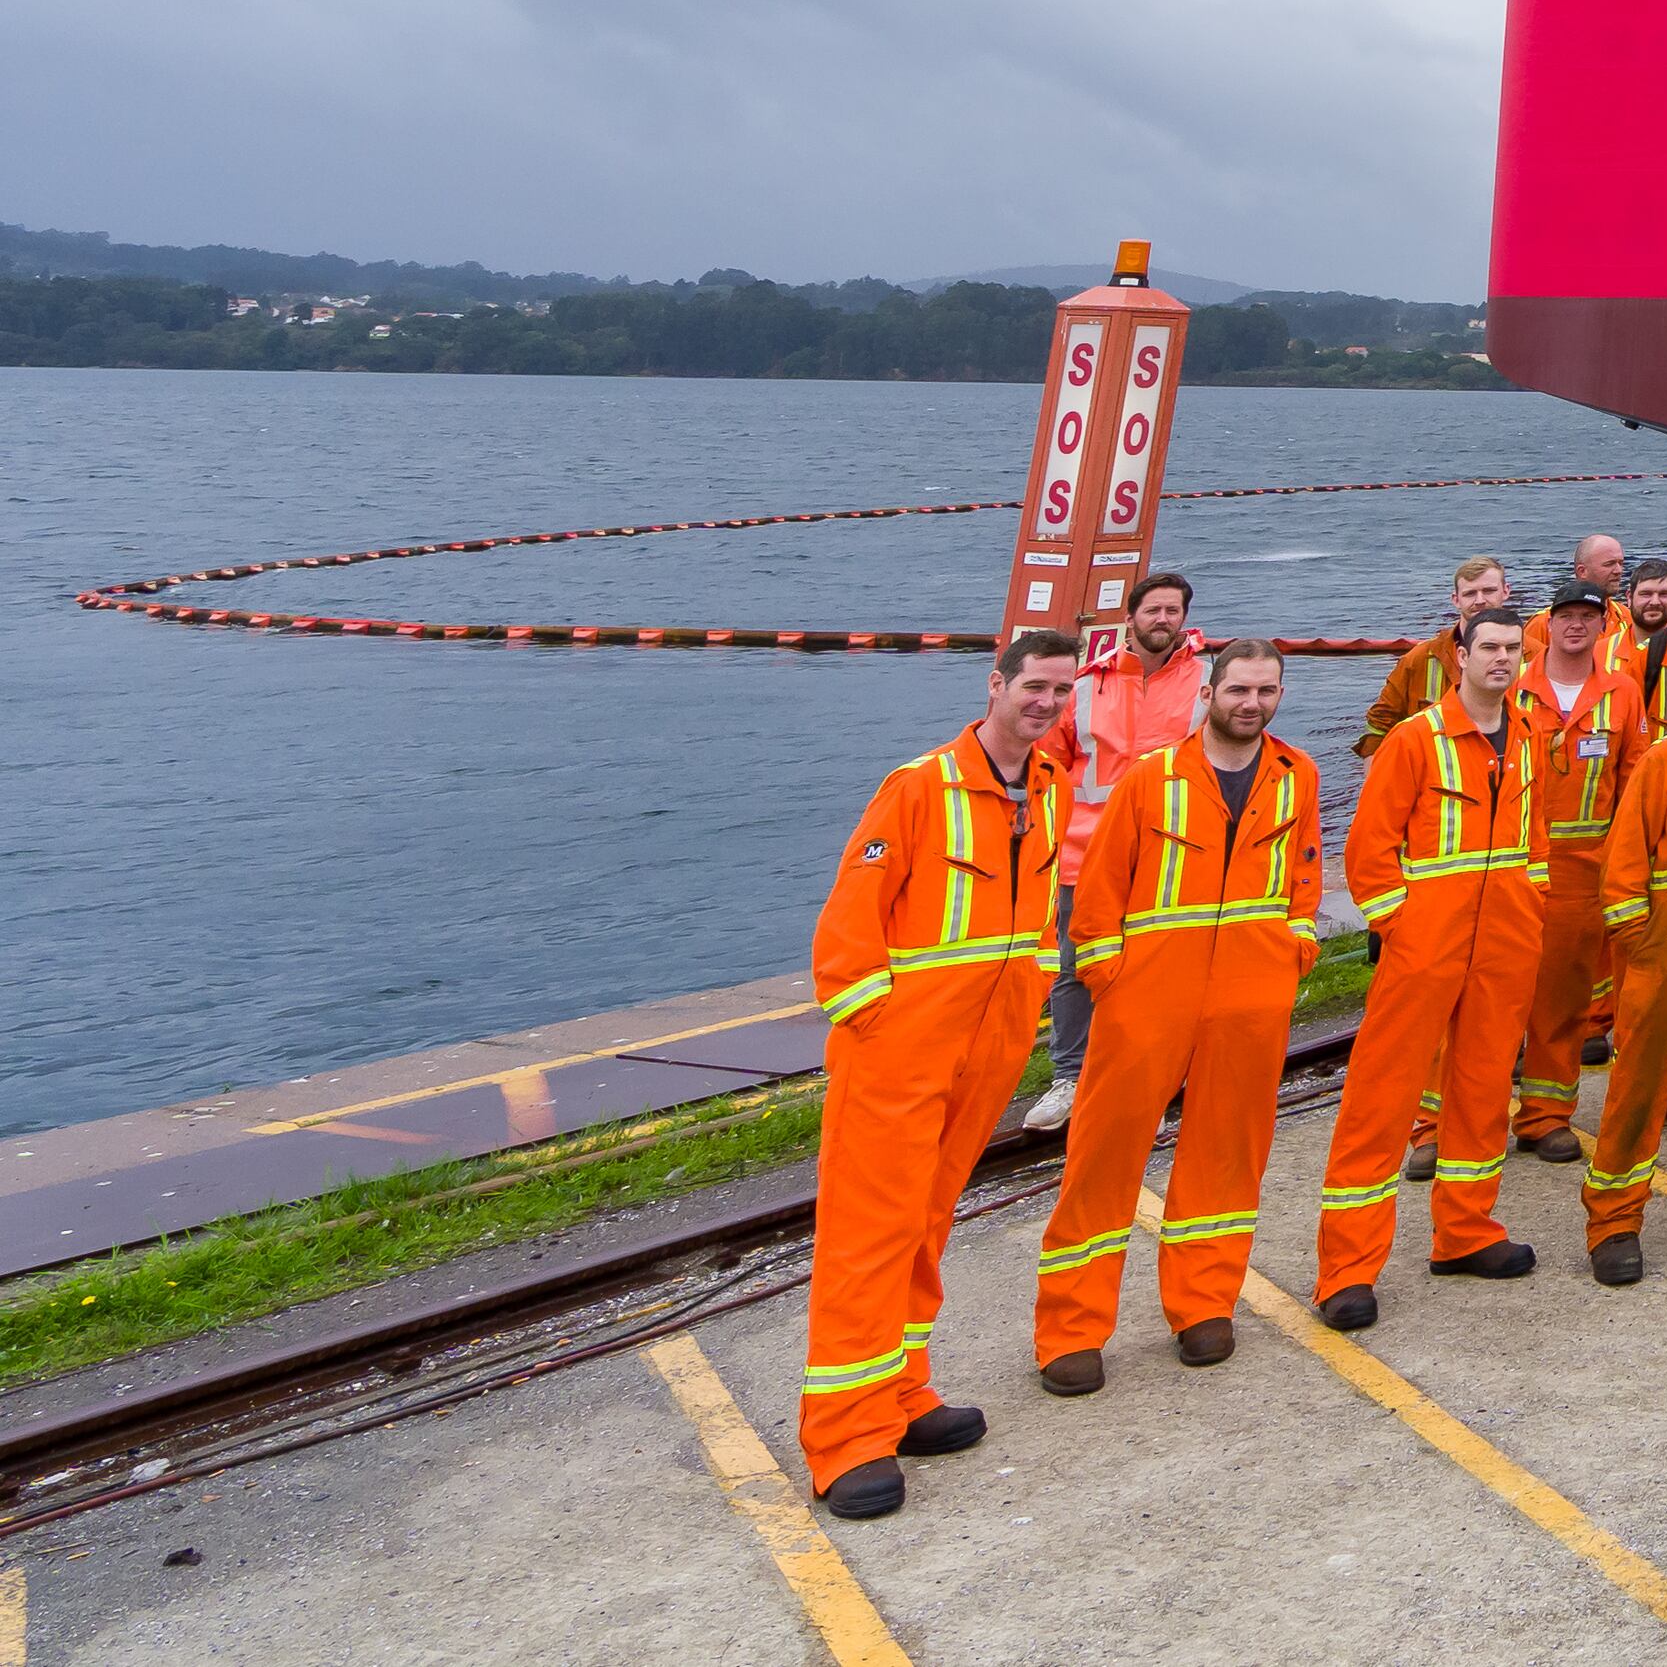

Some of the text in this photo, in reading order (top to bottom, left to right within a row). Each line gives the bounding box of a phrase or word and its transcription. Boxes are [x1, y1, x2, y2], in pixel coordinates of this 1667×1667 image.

[1044, 342, 1096, 525] SOS
[1110, 344, 1162, 525] SOS
[866, 845, 884, 857] M
